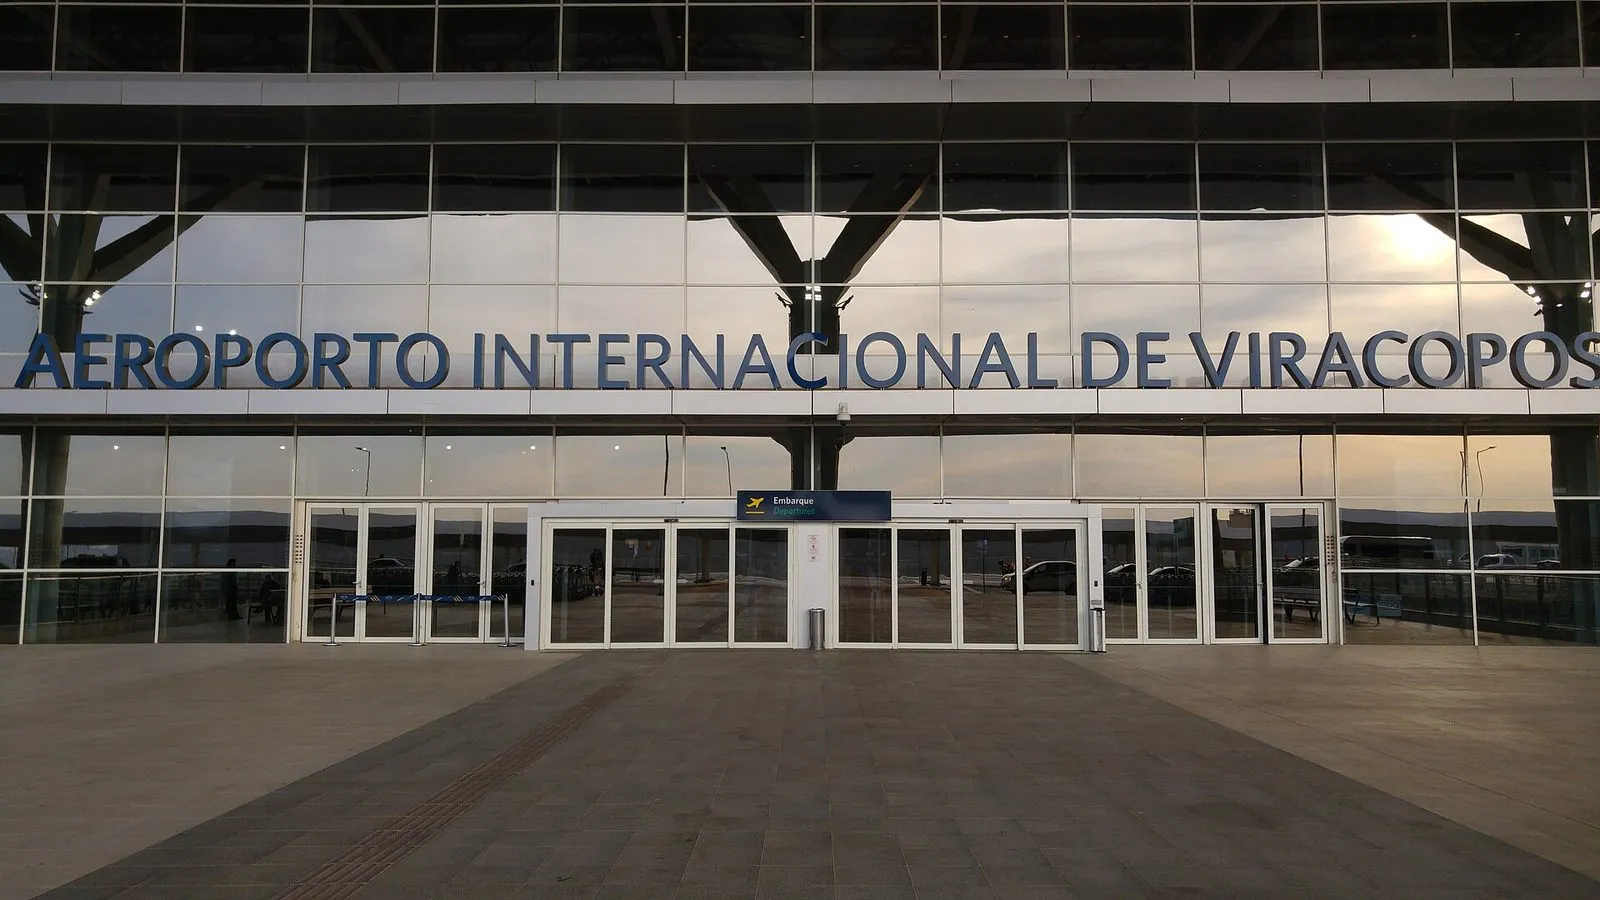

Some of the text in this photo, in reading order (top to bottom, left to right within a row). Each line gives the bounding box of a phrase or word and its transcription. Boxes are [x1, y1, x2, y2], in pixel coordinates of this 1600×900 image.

[14, 330, 1600, 390] AEROPORTO INTERNACIONAL DE VIRACOPOS
[773, 496, 814, 506] Embarque
[773, 507, 815, 516] Departures
